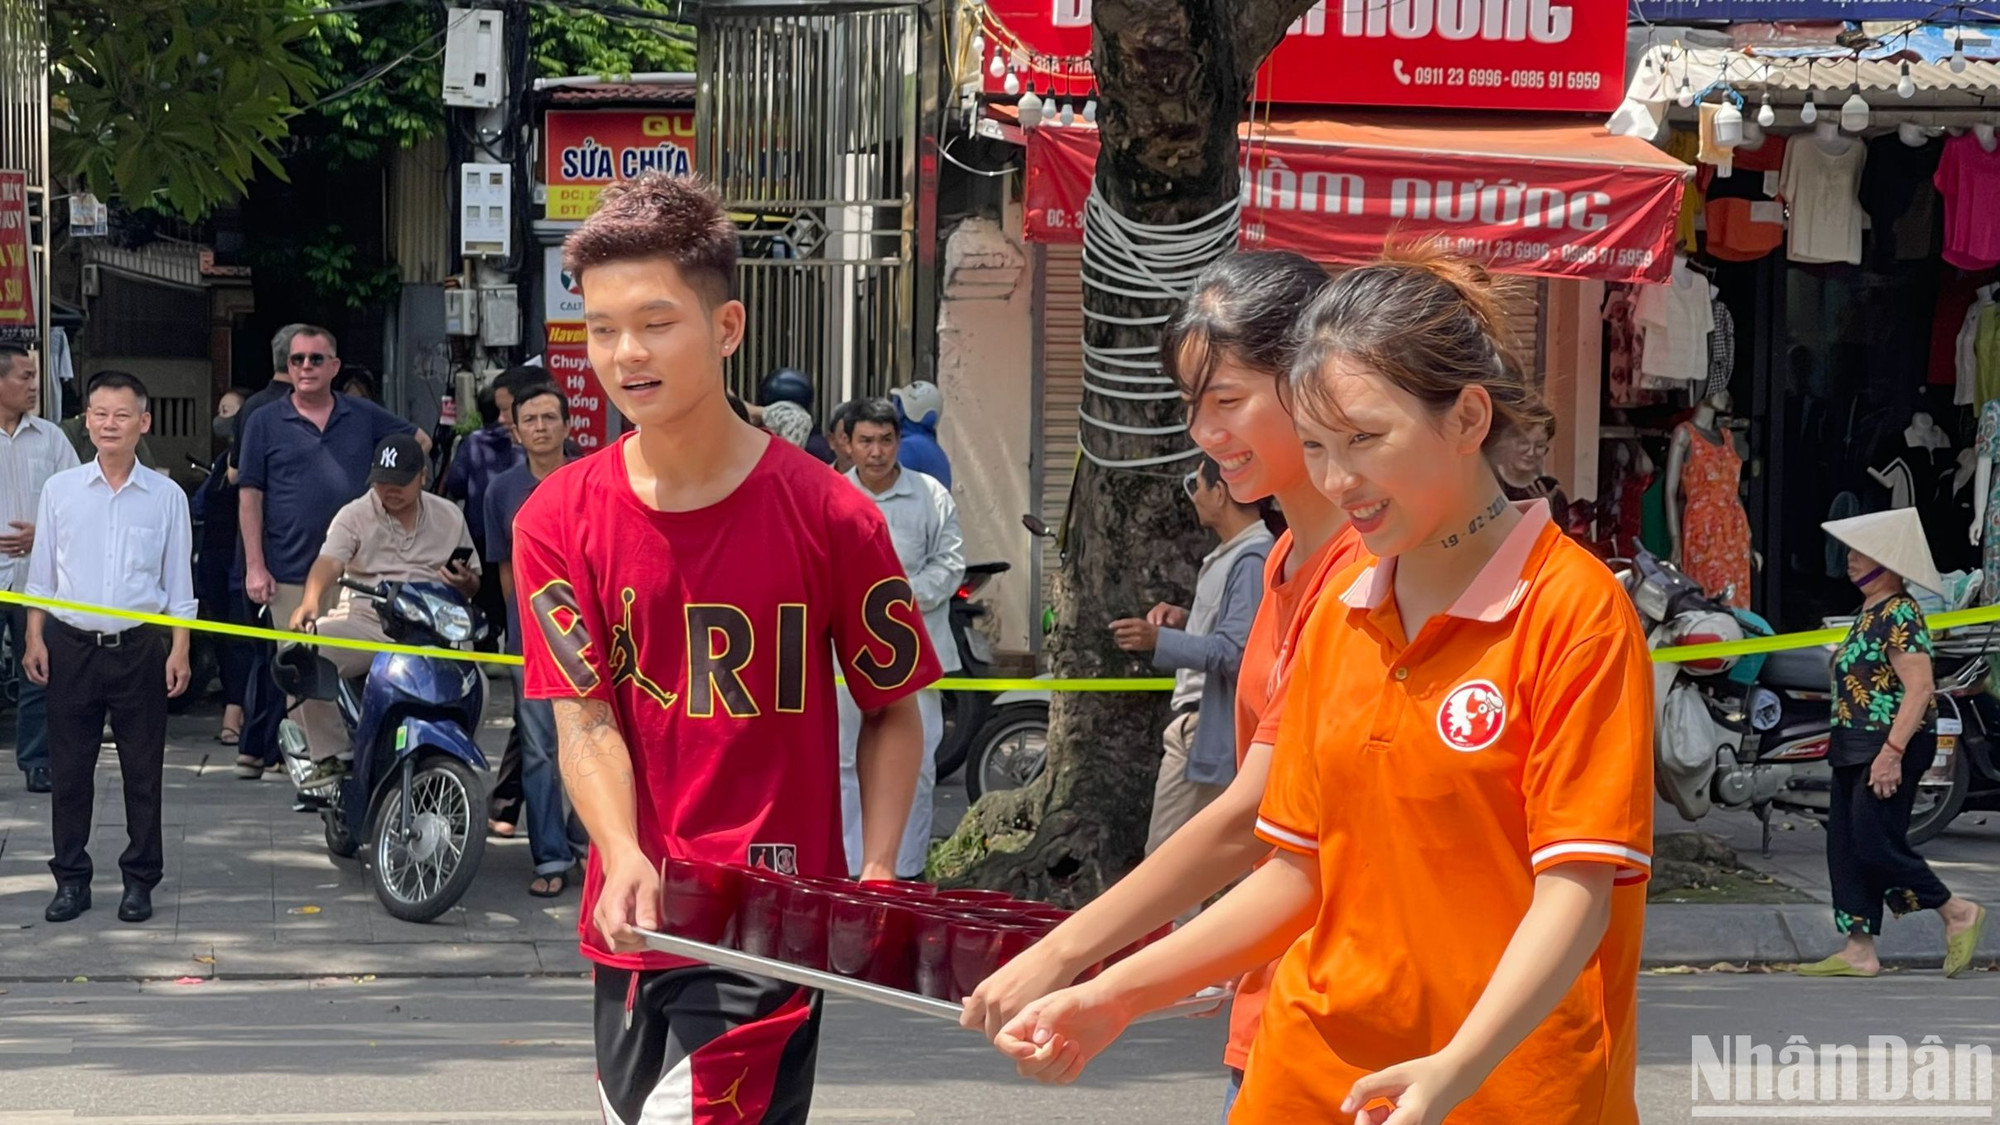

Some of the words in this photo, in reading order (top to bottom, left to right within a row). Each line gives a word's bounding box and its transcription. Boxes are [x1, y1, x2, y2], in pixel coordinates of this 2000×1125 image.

[1414, 67, 1443, 85] 0911
[1447, 68, 1464, 86] 23
[1549, 71, 1563, 88] 91
[1567, 72, 1600, 90] 5959
[562, 137, 616, 180] SỬA
[621, 142, 690, 179] CHỮA
